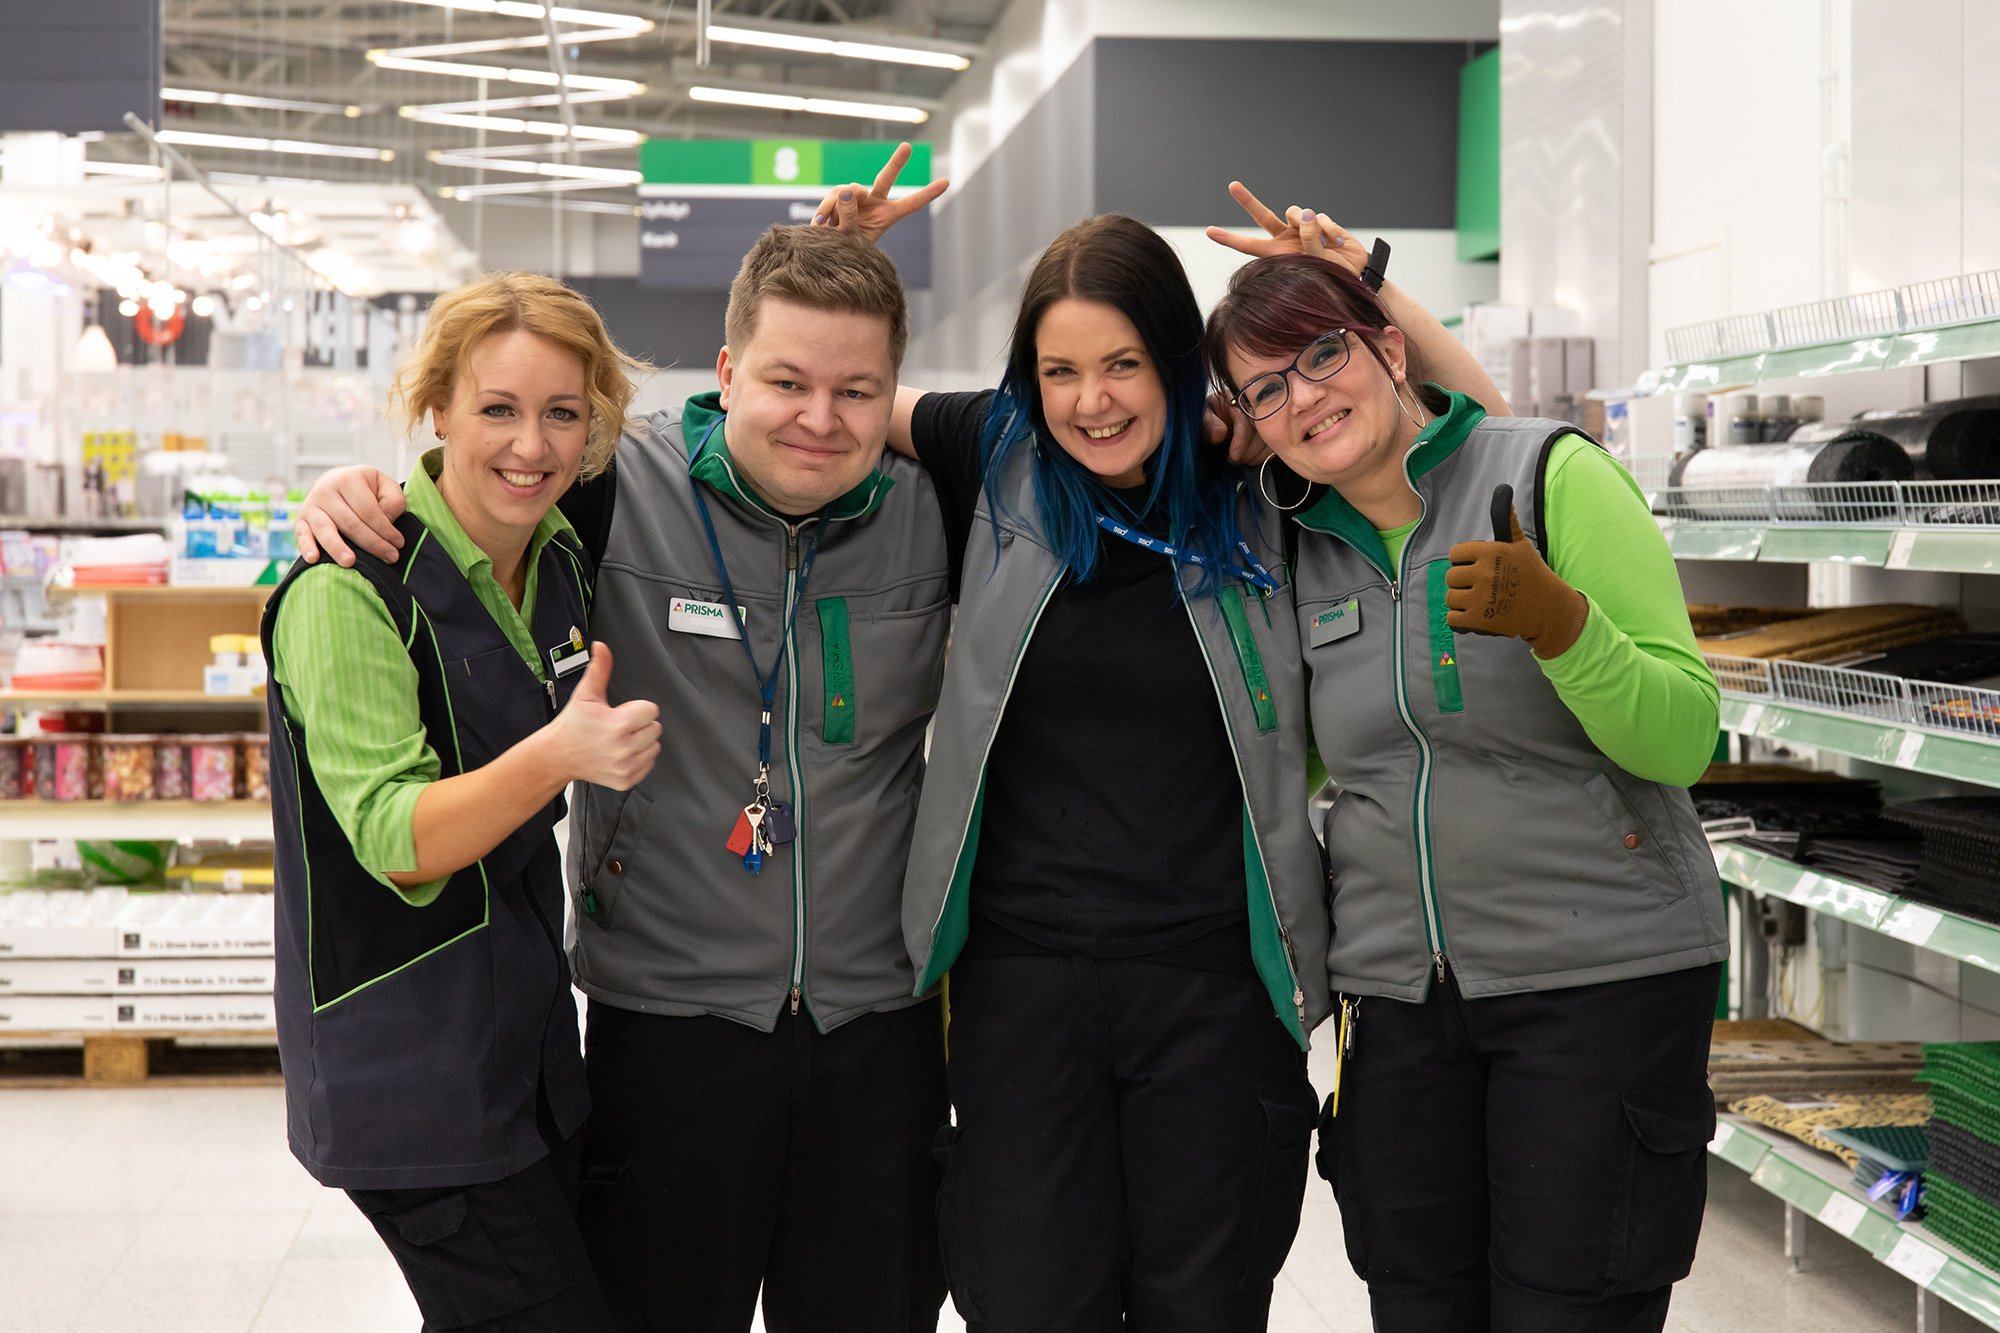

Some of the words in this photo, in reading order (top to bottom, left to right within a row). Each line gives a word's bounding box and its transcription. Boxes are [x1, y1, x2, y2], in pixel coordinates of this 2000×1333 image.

[774, 147, 799, 180] 8
[684, 603, 724, 618] PRISMA
[1318, 609, 1345, 626] PRISMA
